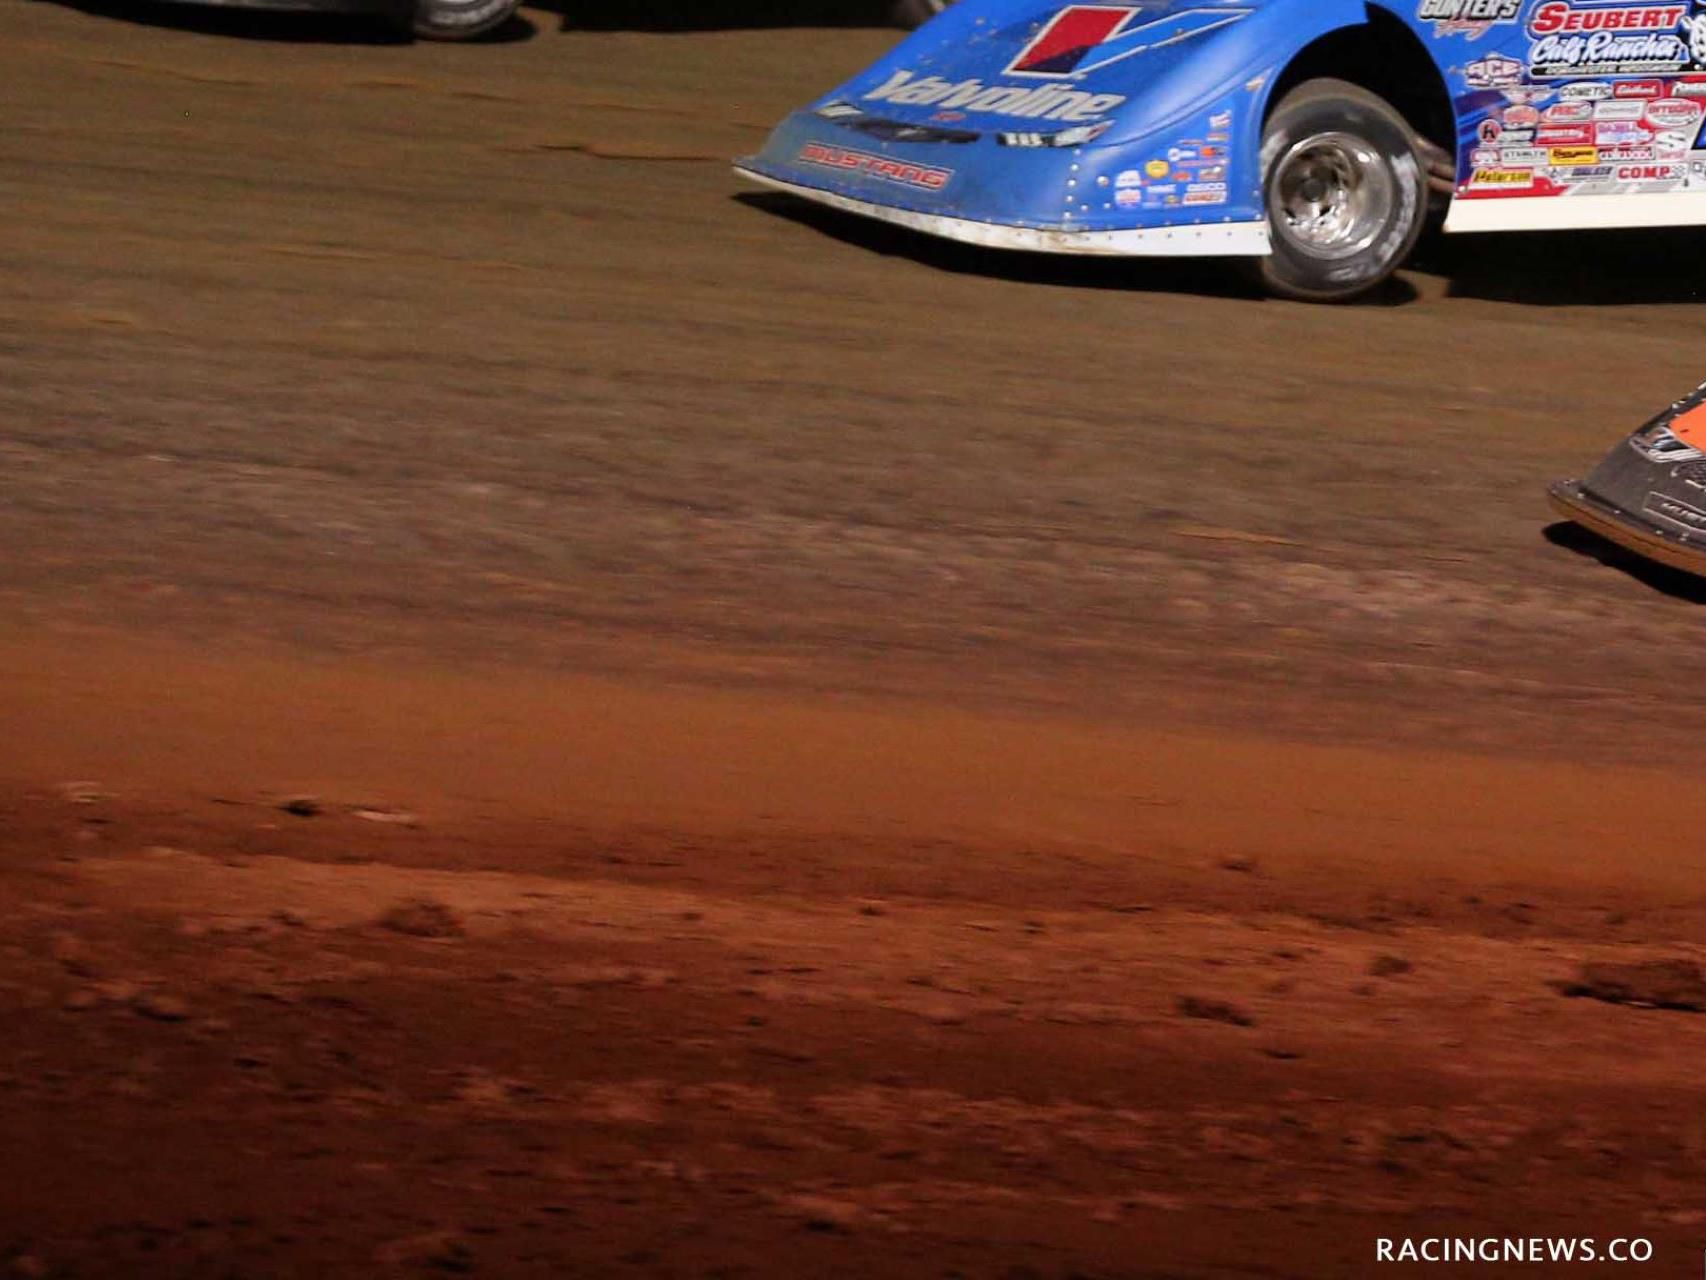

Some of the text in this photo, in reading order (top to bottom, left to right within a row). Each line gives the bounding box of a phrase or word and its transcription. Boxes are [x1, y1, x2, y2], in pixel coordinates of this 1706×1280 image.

[1531, 2, 1688, 35] SEUBERT
[862, 70, 1127, 120] Valvoline
[801, 145, 948, 188] MUSTANG
[1618, 166, 1671, 179] COMP
